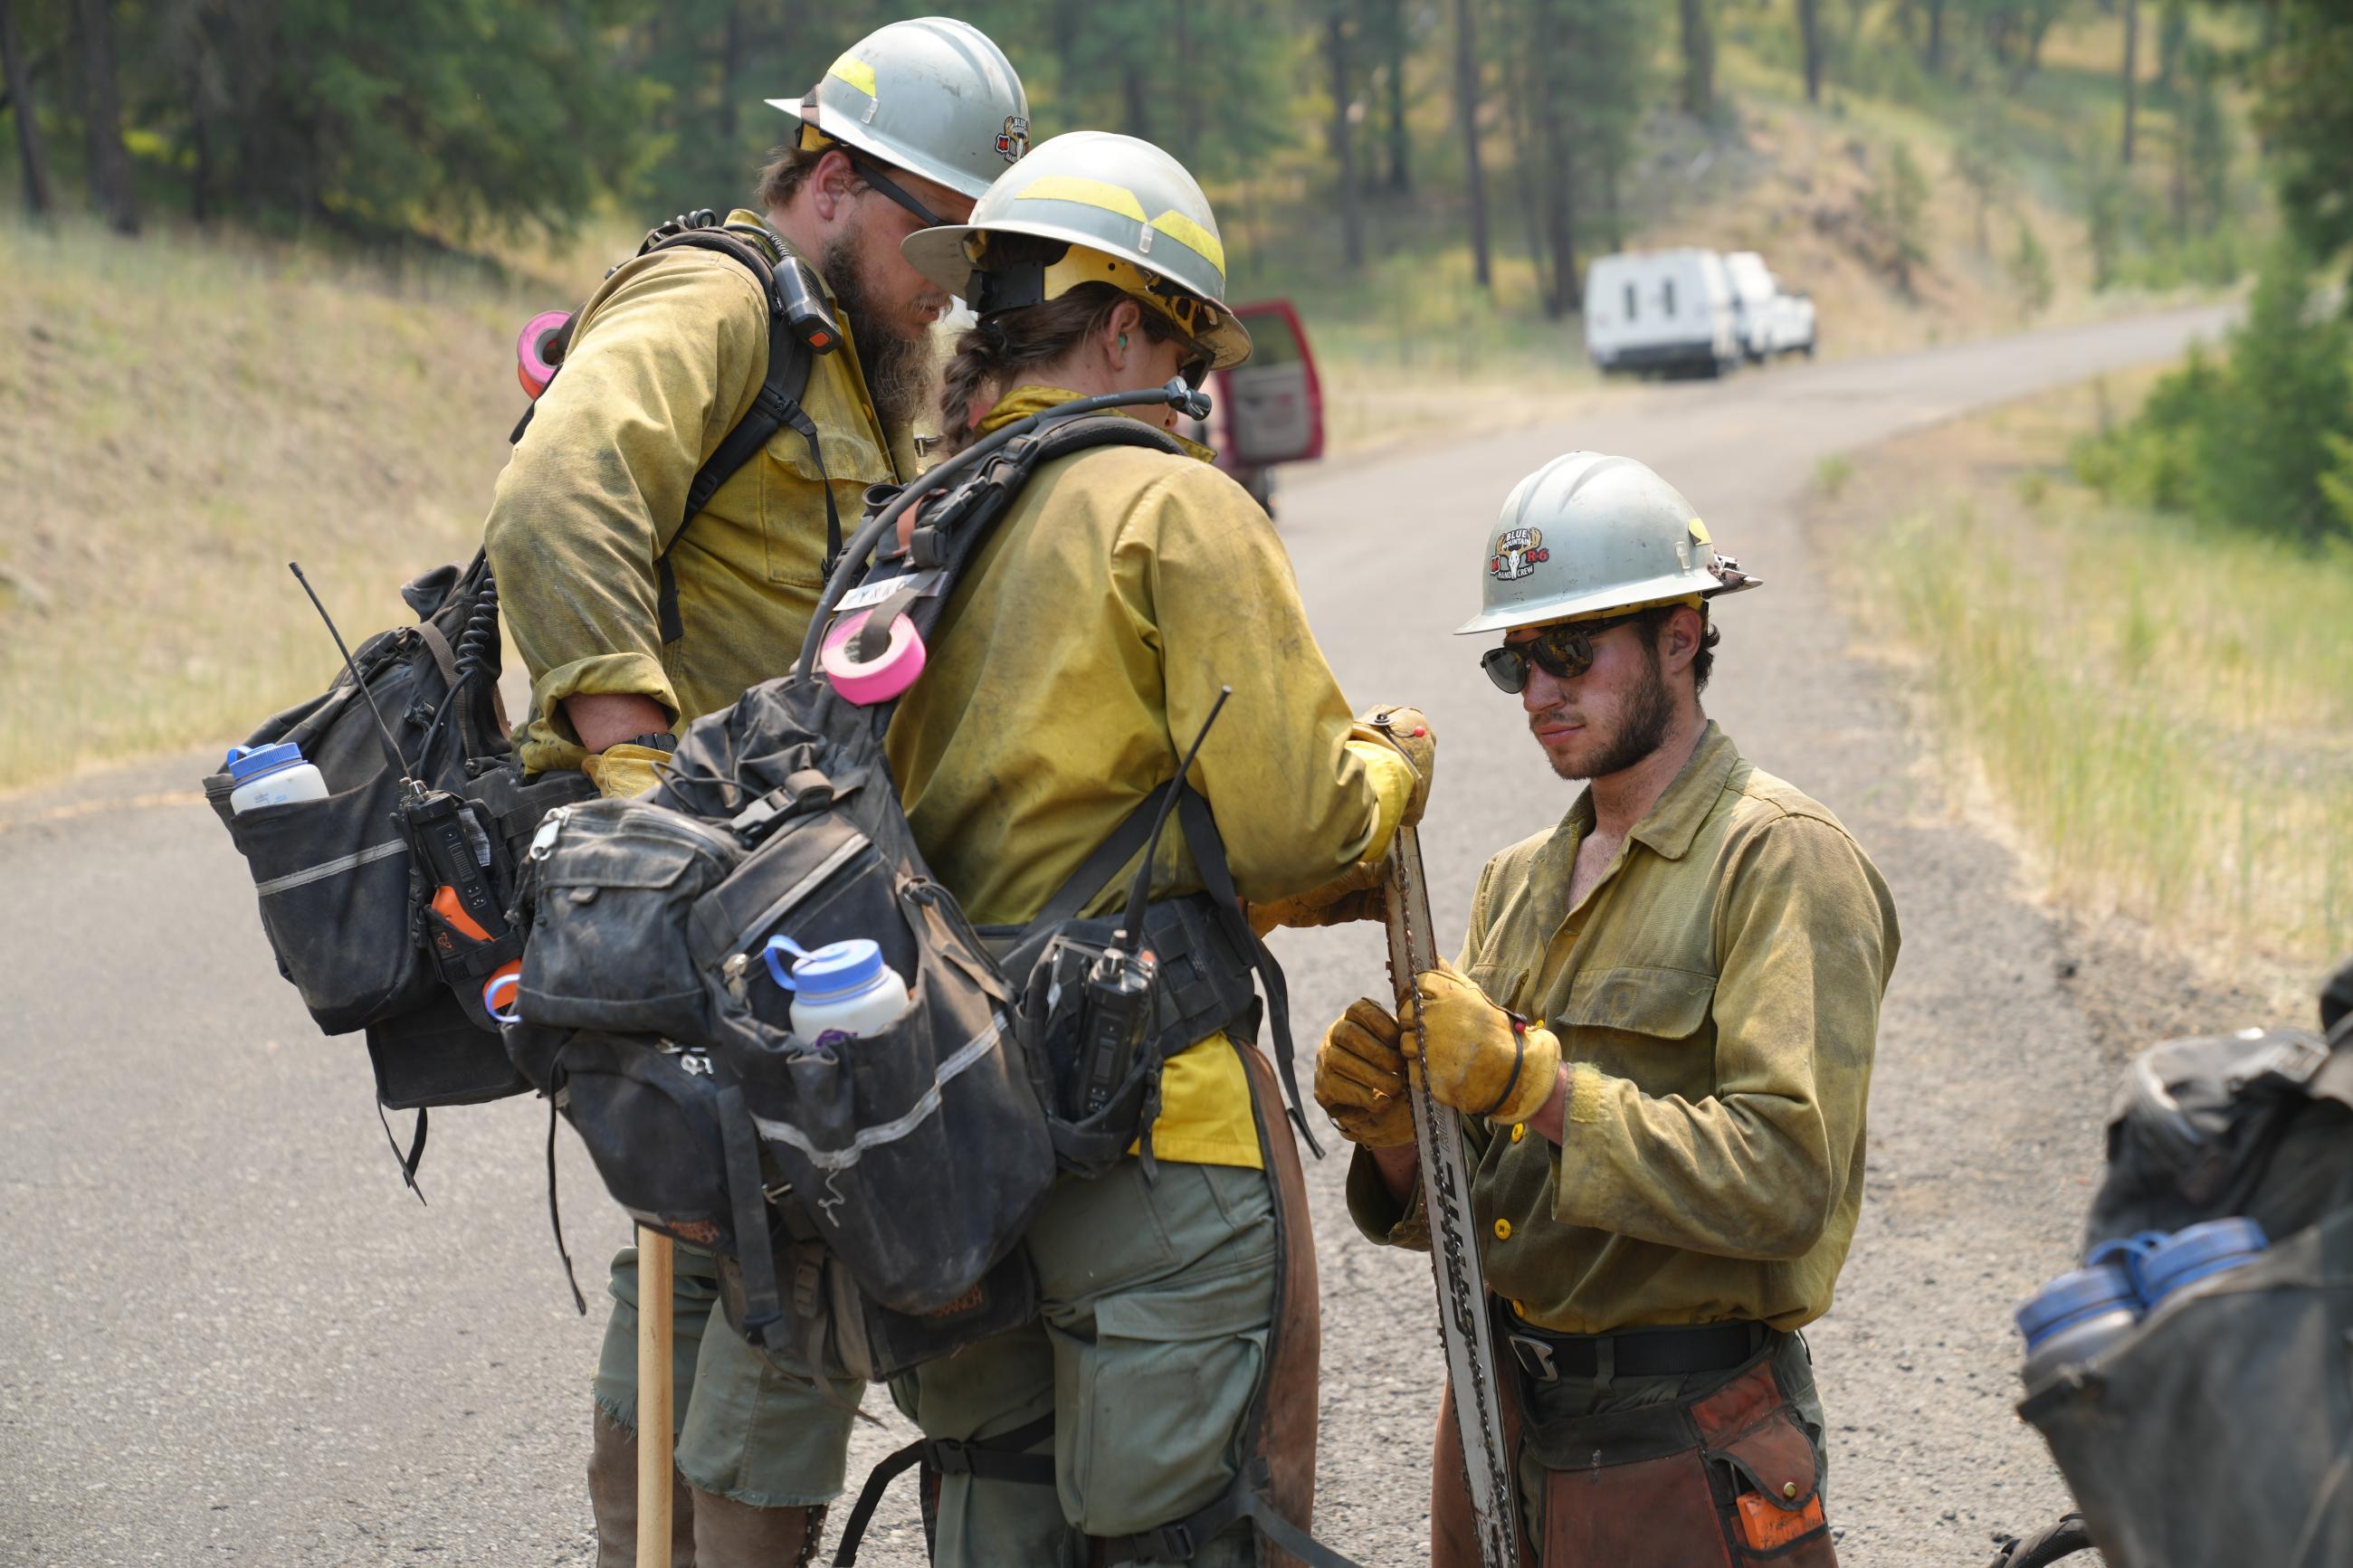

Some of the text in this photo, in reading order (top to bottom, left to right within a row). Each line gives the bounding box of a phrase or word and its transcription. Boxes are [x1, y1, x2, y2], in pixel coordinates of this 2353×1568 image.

[1506, 529, 1527, 541] BLUE
[1527, 549, 1548, 562] R-6
[1498, 565, 1533, 579] HAND CREW
